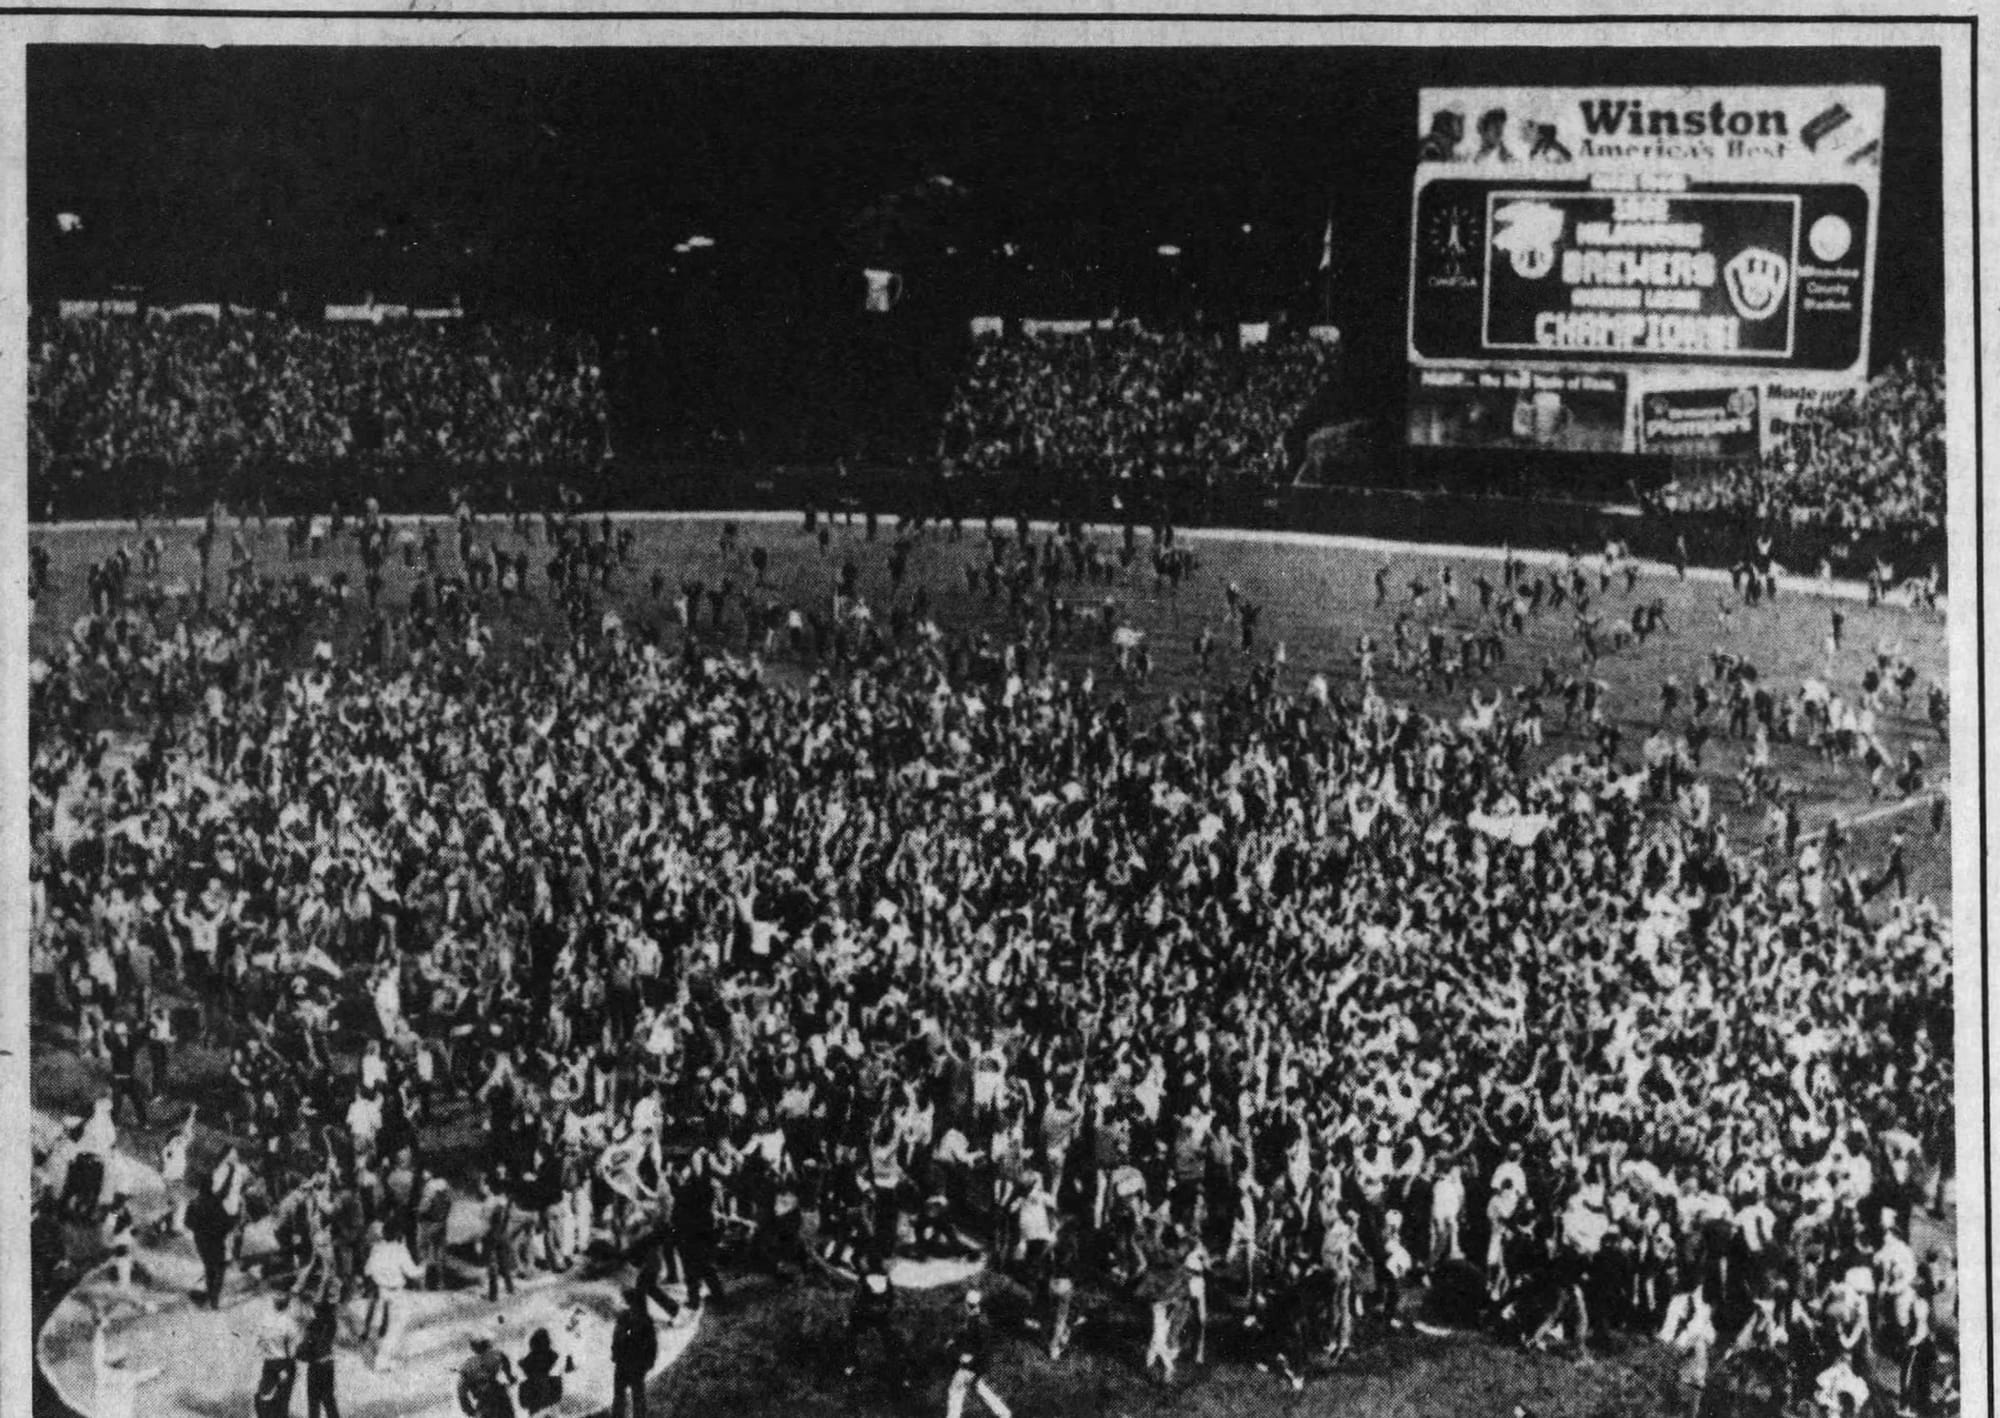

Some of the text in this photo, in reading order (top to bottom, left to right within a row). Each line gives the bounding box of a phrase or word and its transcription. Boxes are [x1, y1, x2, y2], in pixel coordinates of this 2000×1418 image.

[1579, 99, 1788, 137] Winston
[1579, 138, 1786, 159] America's Best
[1562, 250, 1717, 287] BREWERS
[1767, 383, 1818, 400] Made
